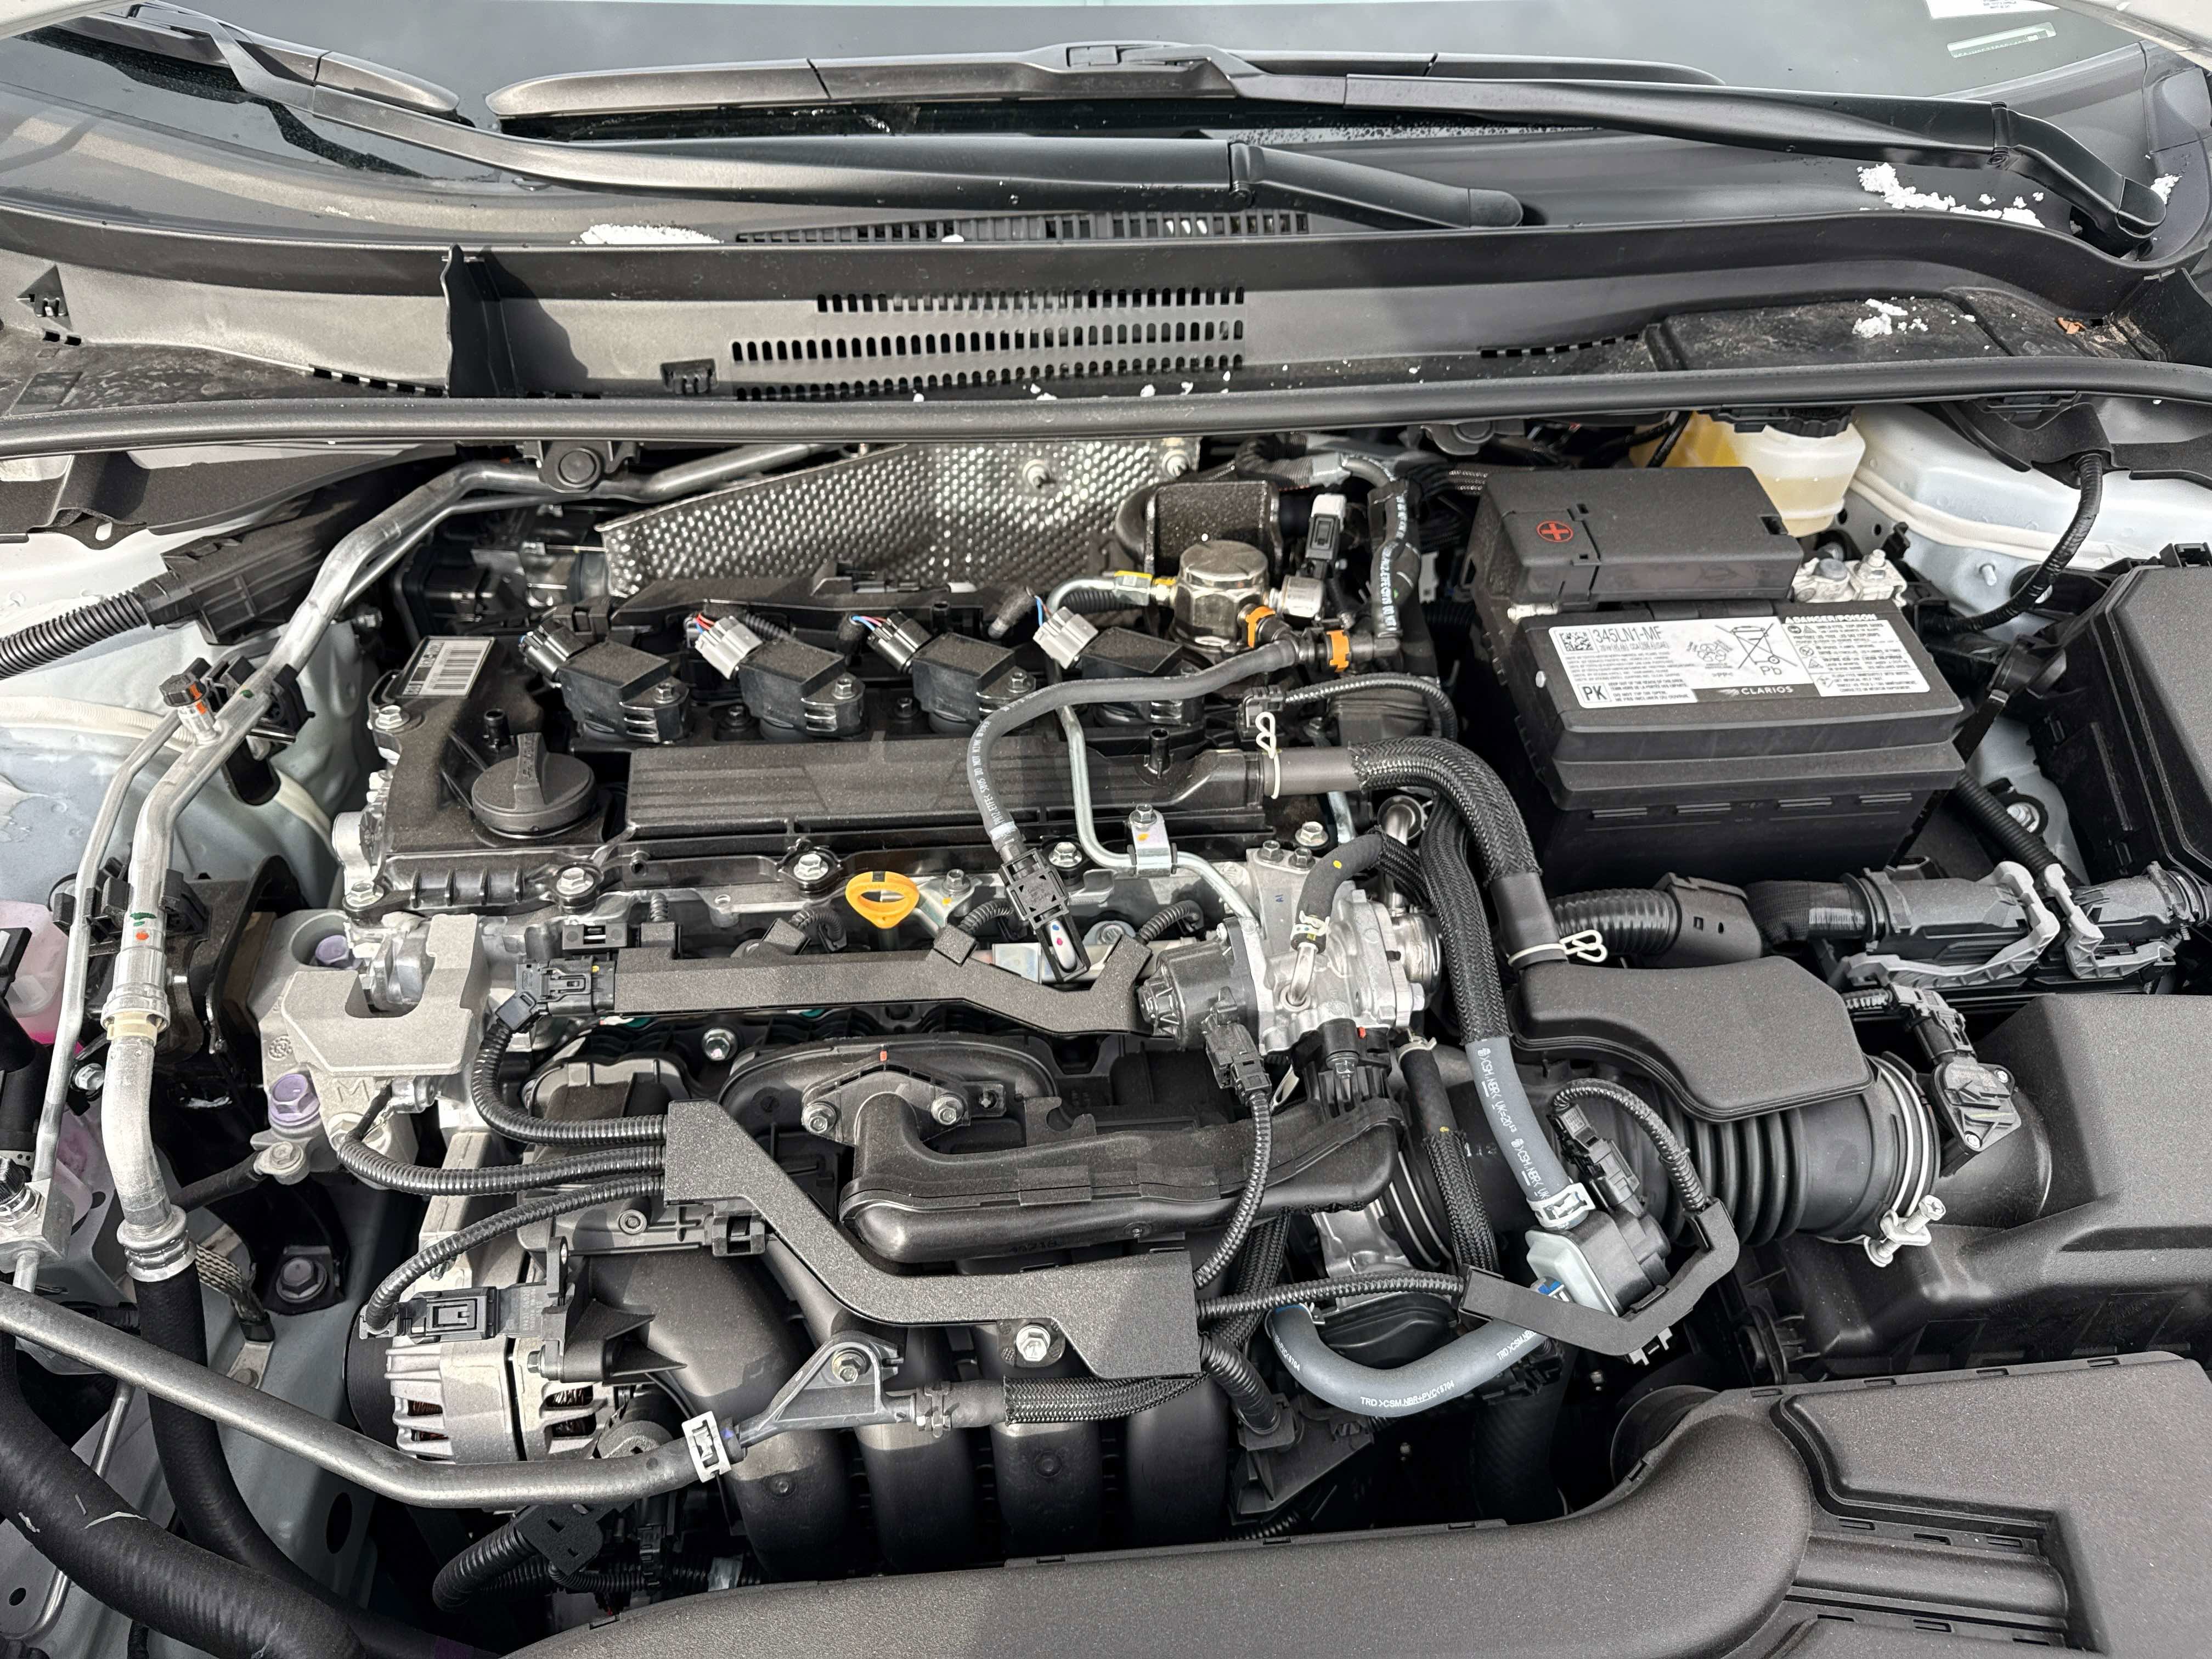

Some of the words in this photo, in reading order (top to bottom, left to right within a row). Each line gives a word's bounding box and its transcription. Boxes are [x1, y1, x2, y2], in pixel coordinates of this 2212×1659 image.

[1593, 625, 1662, 643] 345LN1-MF
[1759, 665, 1782, 675] Pb
[1582, 686, 1607, 701] PK
[1741, 685, 1794, 695] CLARIOS
[972, 755, 981, 766] NOT
[974, 768, 984, 776] DO
[1496, 1347, 1509, 1360] TRD
[1360, 1396, 1378, 1407] TRD
